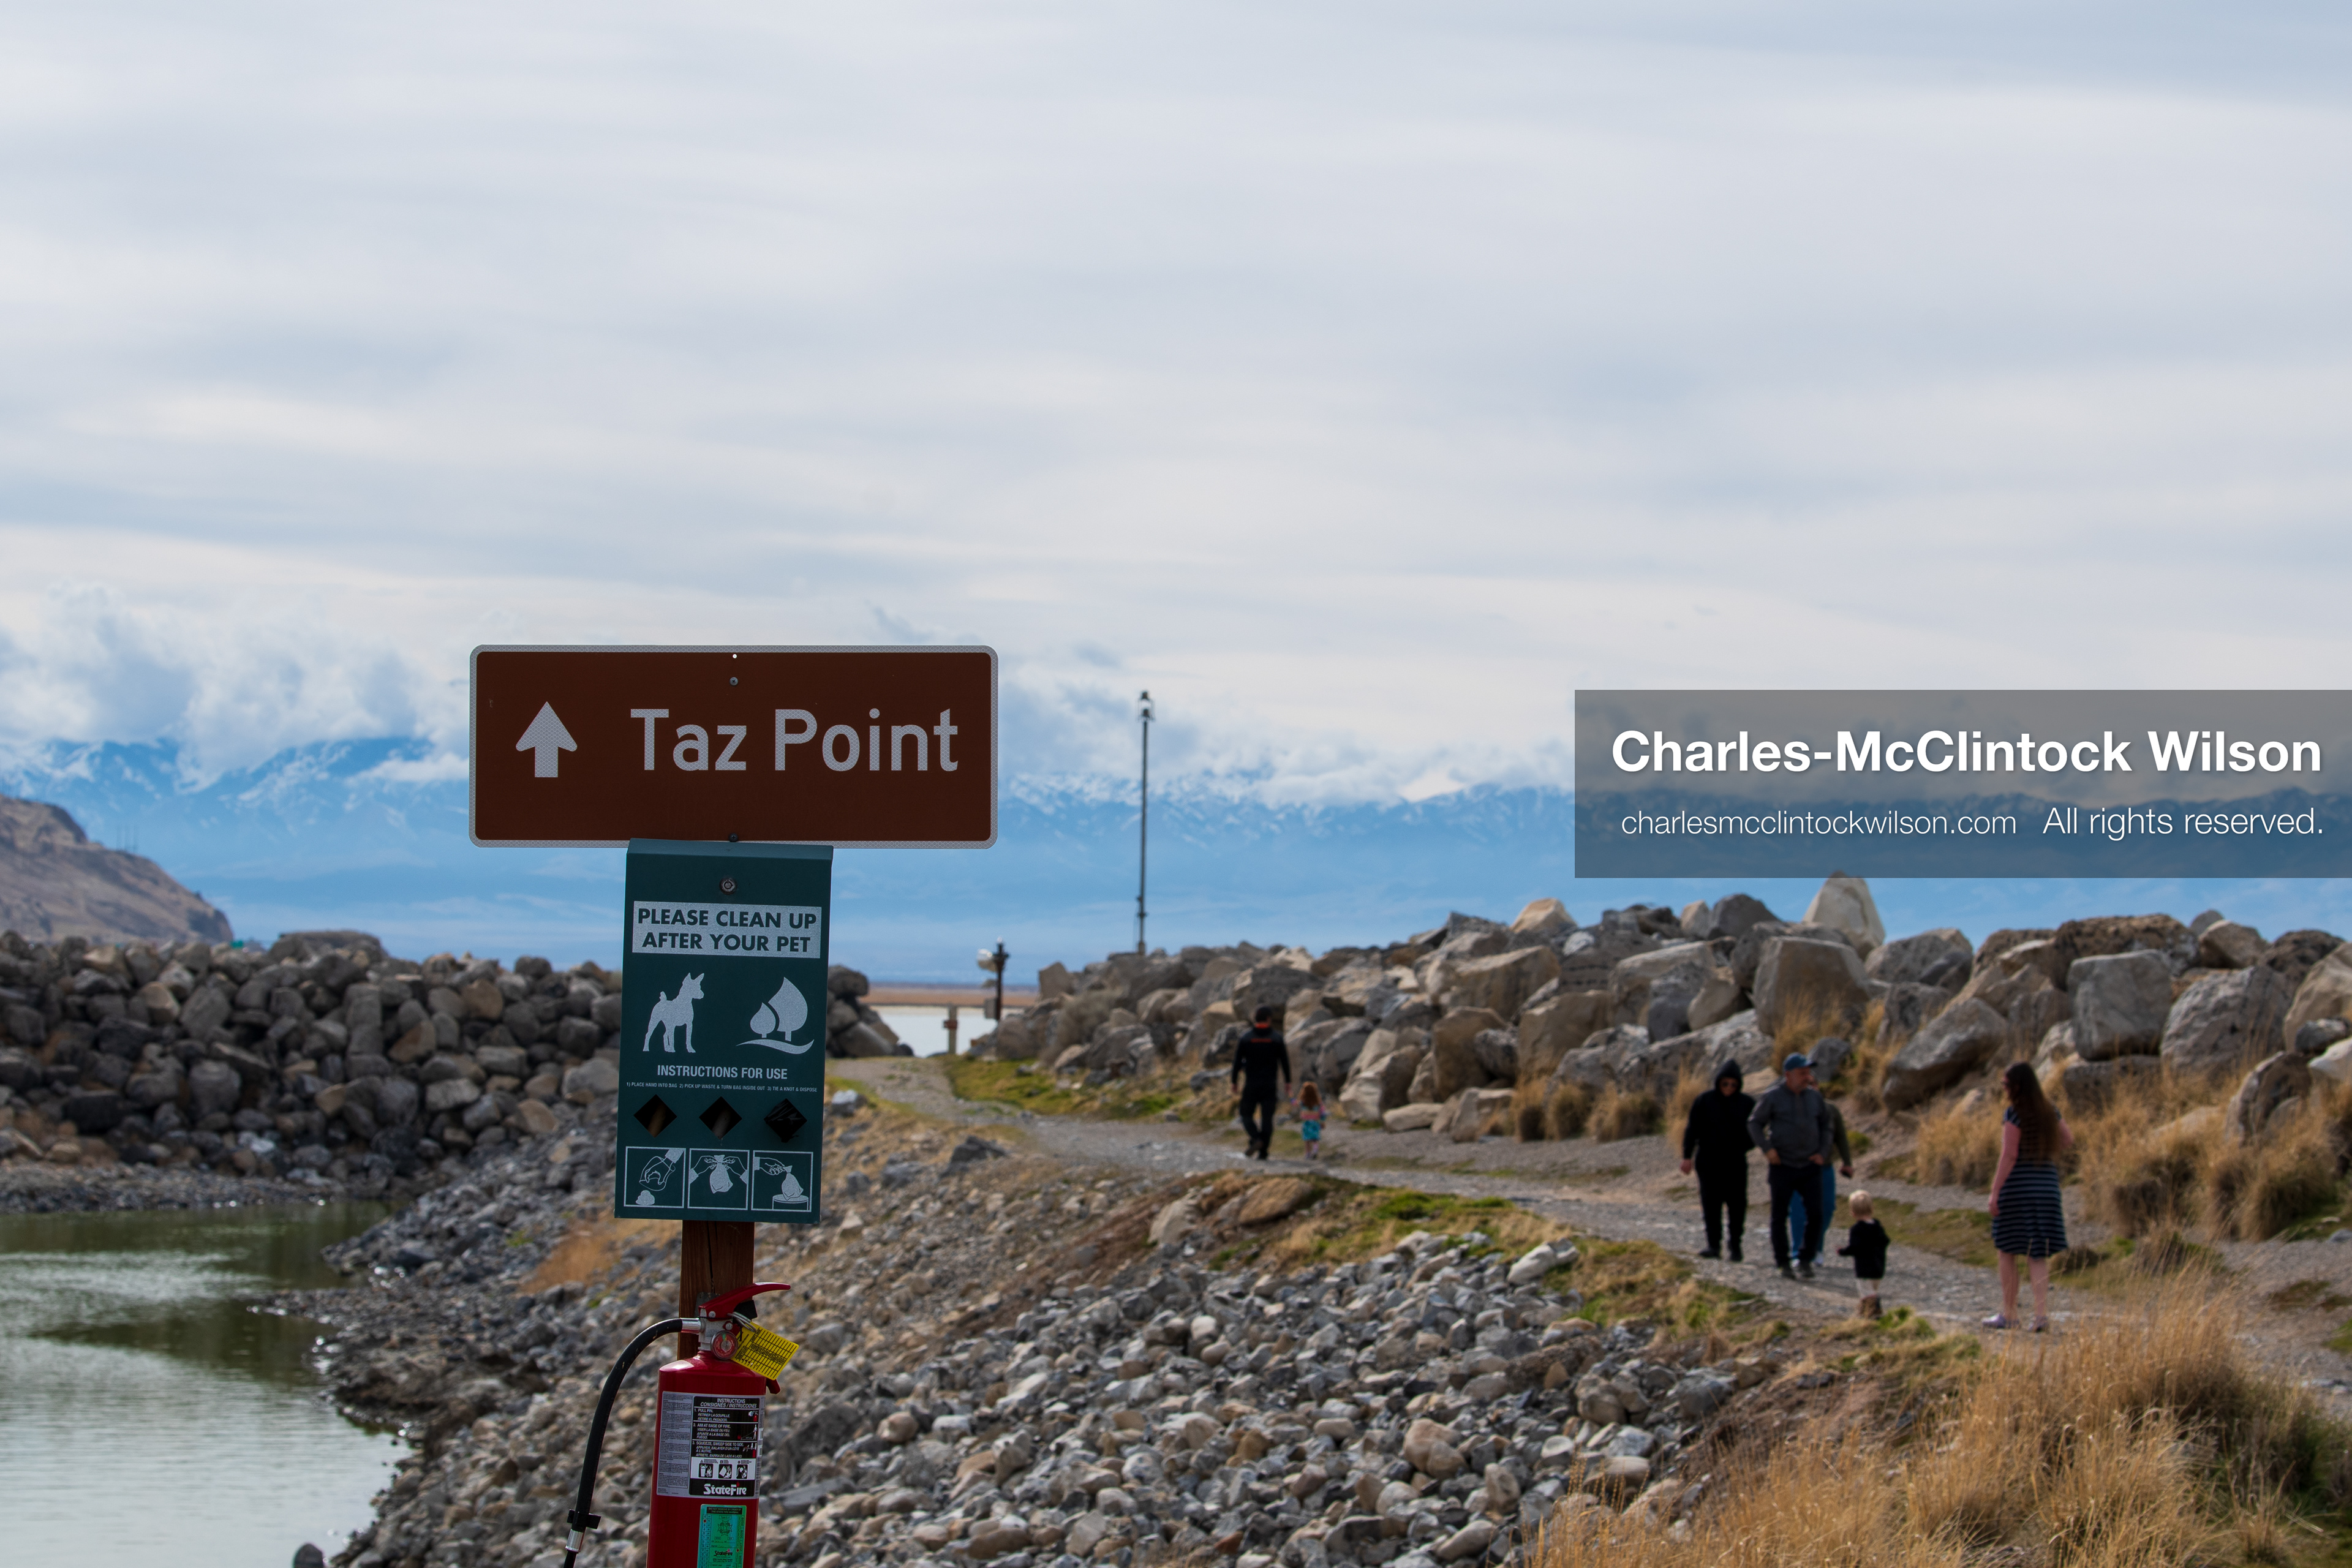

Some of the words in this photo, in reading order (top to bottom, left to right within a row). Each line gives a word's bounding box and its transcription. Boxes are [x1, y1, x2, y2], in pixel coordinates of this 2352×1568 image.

[631, 709, 746, 771] Taz
[775, 709, 958, 771] Point
[638, 908, 708, 925] PLEASE
[716, 911, 781, 928] CLEAN
[789, 913, 817, 929] UP
[642, 932, 703, 949] AFTER
[709, 934, 769, 951] YOUR
[777, 936, 810, 952] PET
[658, 1065, 737, 1077] INSTRUCTIONS
[742, 1068, 763, 1078] FOR
[767, 1068, 787, 1079] USE
[703, 1482, 747, 1496] StateFire
